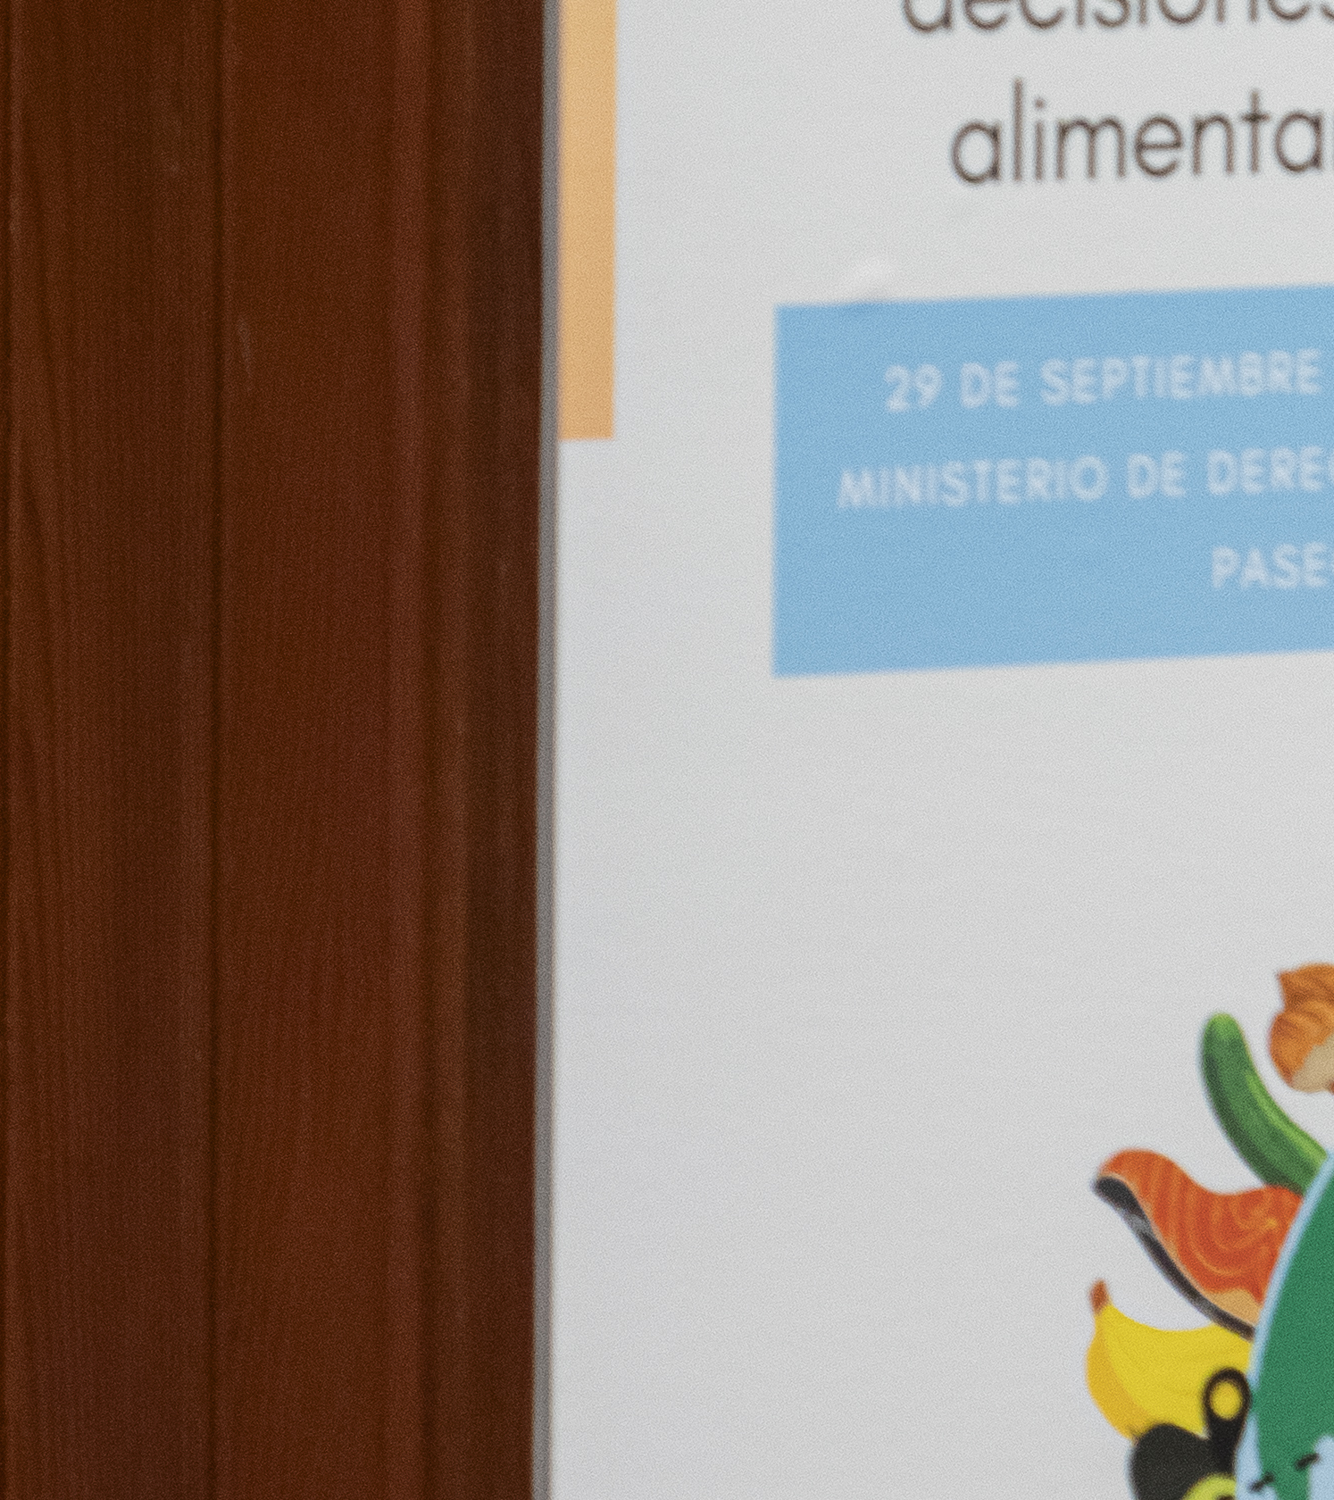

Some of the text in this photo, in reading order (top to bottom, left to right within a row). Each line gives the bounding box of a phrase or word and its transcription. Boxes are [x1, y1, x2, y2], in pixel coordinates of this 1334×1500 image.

[882, 360, 946, 416] 29
[957, 357, 1022, 412] DE
[1037, 345, 1323, 408] SEPTIEMBRE
[834, 452, 1111, 511] MINISTERIO
[1124, 448, 1189, 502] DE
